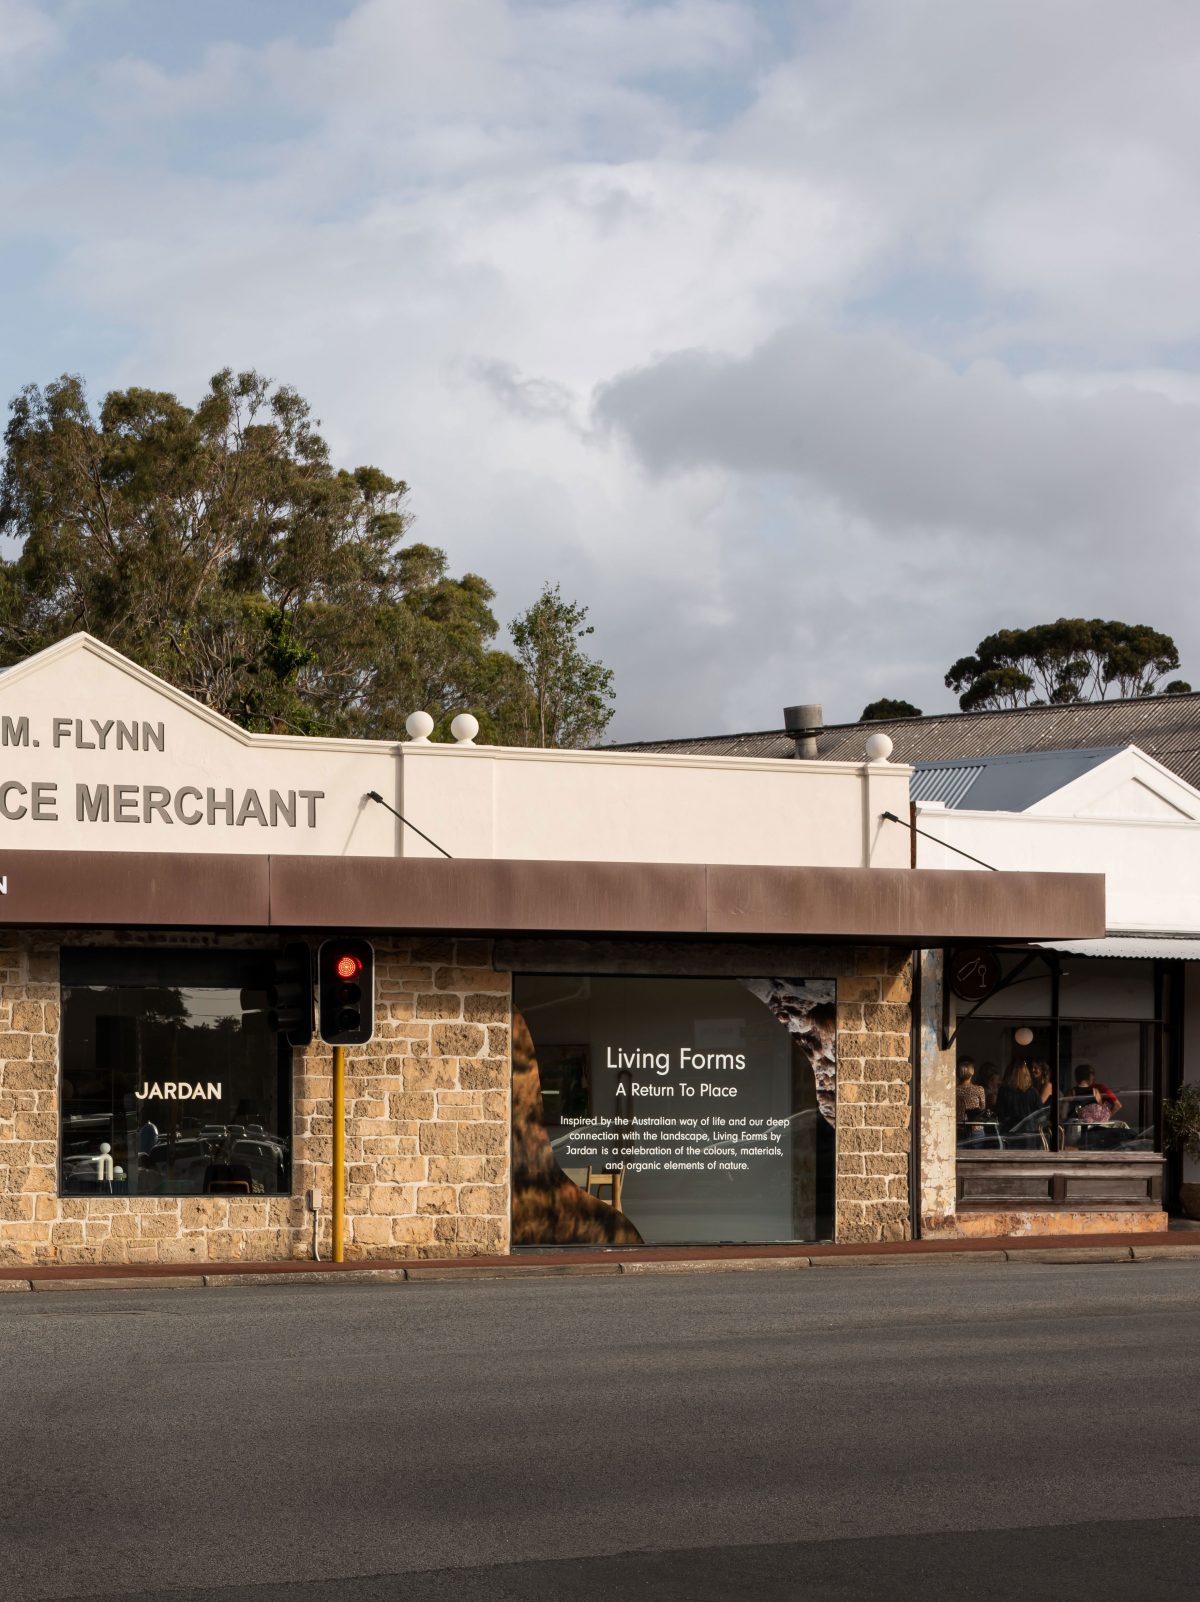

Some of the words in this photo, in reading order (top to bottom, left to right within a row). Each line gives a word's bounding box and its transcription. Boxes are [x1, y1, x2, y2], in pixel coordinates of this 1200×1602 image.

[1, 716, 40, 748] M.
[52, 718, 165, 752] FLYNN
[75, 783, 326, 829] MERCHANT
[607, 1046, 670, 1076] Living
[680, 1047, 746, 1070] Forms
[135, 1082, 222, 1100] JARDAN
[615, 1082, 627, 1096] A
[631, 1082, 675, 1097] Return
[679, 1083, 695, 1097] To
[700, 1083, 738, 1098] Place
[560, 1115, 598, 1128] Inspired
[601, 1116, 612, 1128] by
[615, 1116, 629, 1126] the
[632, 1116, 677, 1126] Australian
[680, 1118, 698, 1128] way
[701, 1116, 710, 1126] of
[712, 1116, 726, 1126] life
[729, 1116, 746, 1126] and
[749, 1118, 764, 1126] our
[767, 1117, 790, 1129] deep
[569, 1131, 619, 1141] connection
[622, 1131, 641, 1141] with
[643, 1131, 658, 1141] the
[660, 1131, 710, 1143] landscape,
[713, 1131, 738, 1144] Living
[741, 1131, 768, 1141] Forms
[770, 1131, 782, 1144] by
[566, 1145, 598, 1155] Jardan
[601, 1146, 609, 1155] is
[612, 1147, 619, 1155] a
[621, 1145, 672, 1156] celebration
[675, 1145, 684, 1155] of
[686, 1146, 701, 1155] the
[703, 1146, 738, 1157] colours,
[740, 1146, 784, 1157] materials,
[605, 1160, 624, 1170] and
[626, 1160, 661, 1173] organic
[664, 1160, 705, 1170] elements
[707, 1160, 717, 1170] of
[719, 1161, 750, 1170] nature.
